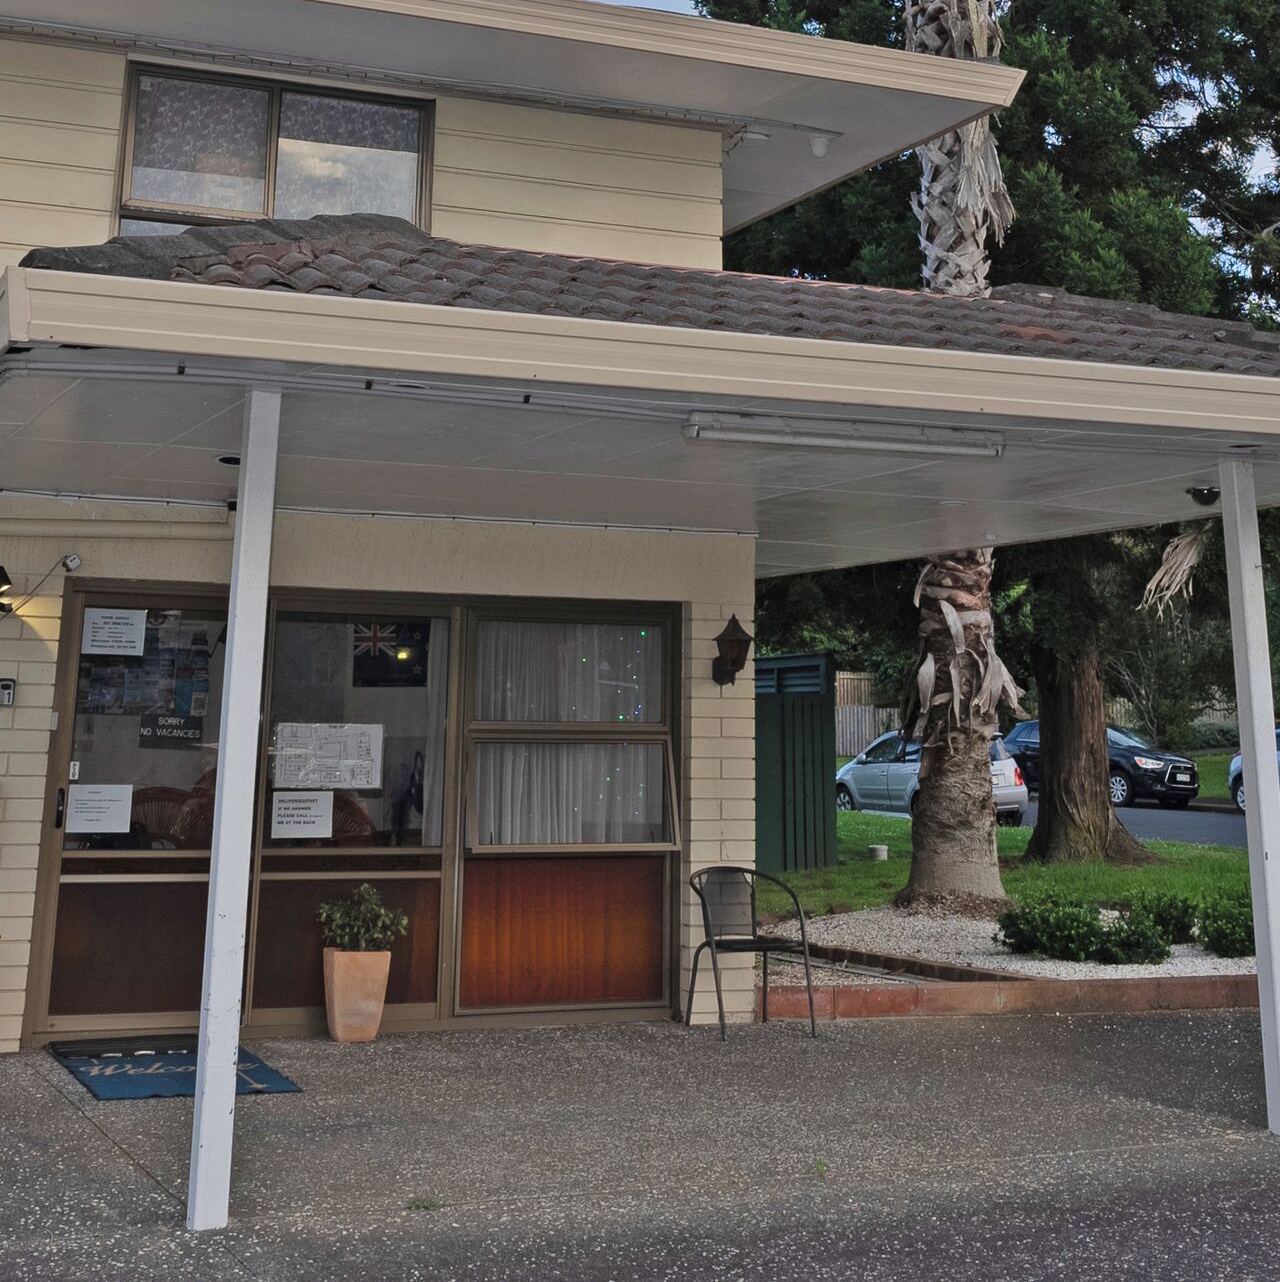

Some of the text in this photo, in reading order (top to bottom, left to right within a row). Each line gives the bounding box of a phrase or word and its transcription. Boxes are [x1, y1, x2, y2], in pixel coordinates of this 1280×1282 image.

[6, 691, 12, 703] 1
[158, 717, 185, 726] SORRY
[140, 727, 201, 738] NO VACANCIES
